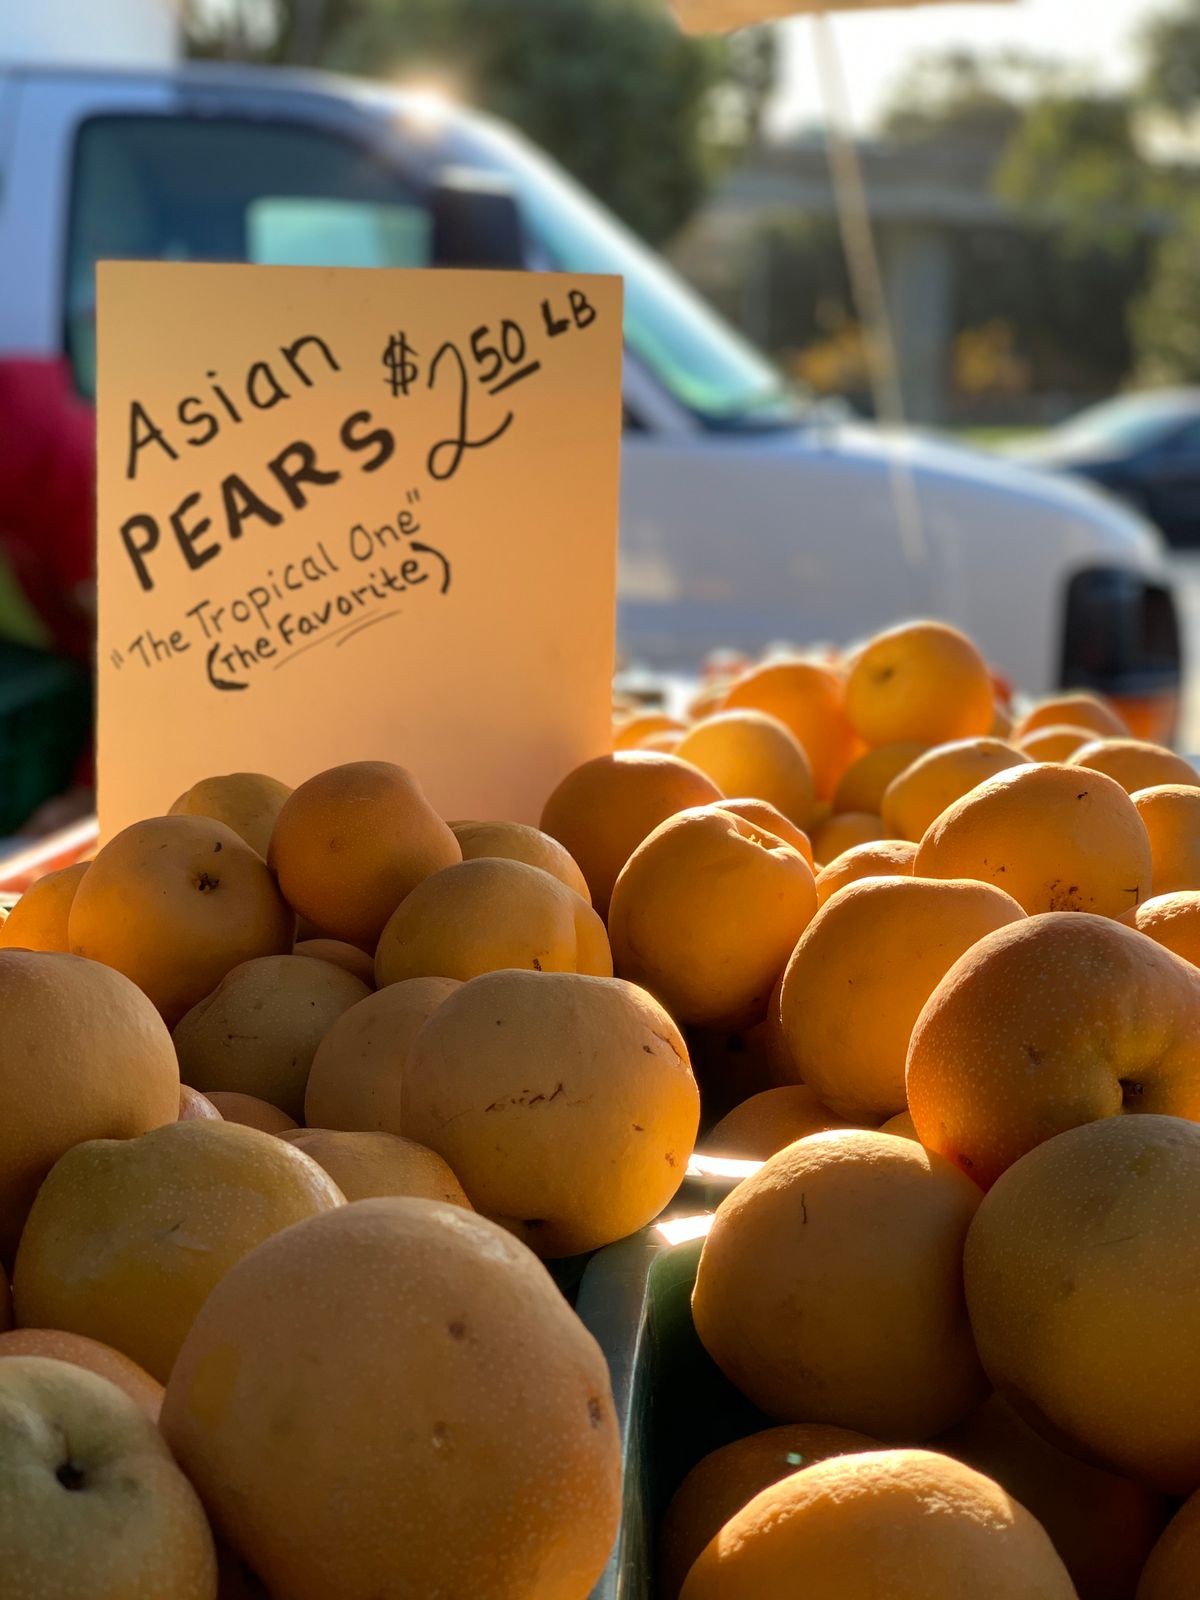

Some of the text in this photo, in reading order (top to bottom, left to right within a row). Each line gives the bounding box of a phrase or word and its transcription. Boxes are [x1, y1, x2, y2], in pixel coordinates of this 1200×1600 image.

[541, 290, 597, 337] LB
[126, 334, 341, 480] Asian
[119, 409, 395, 592] PEARS
[186, 542, 339, 639] Tropical
[348, 489, 422, 562] One"
